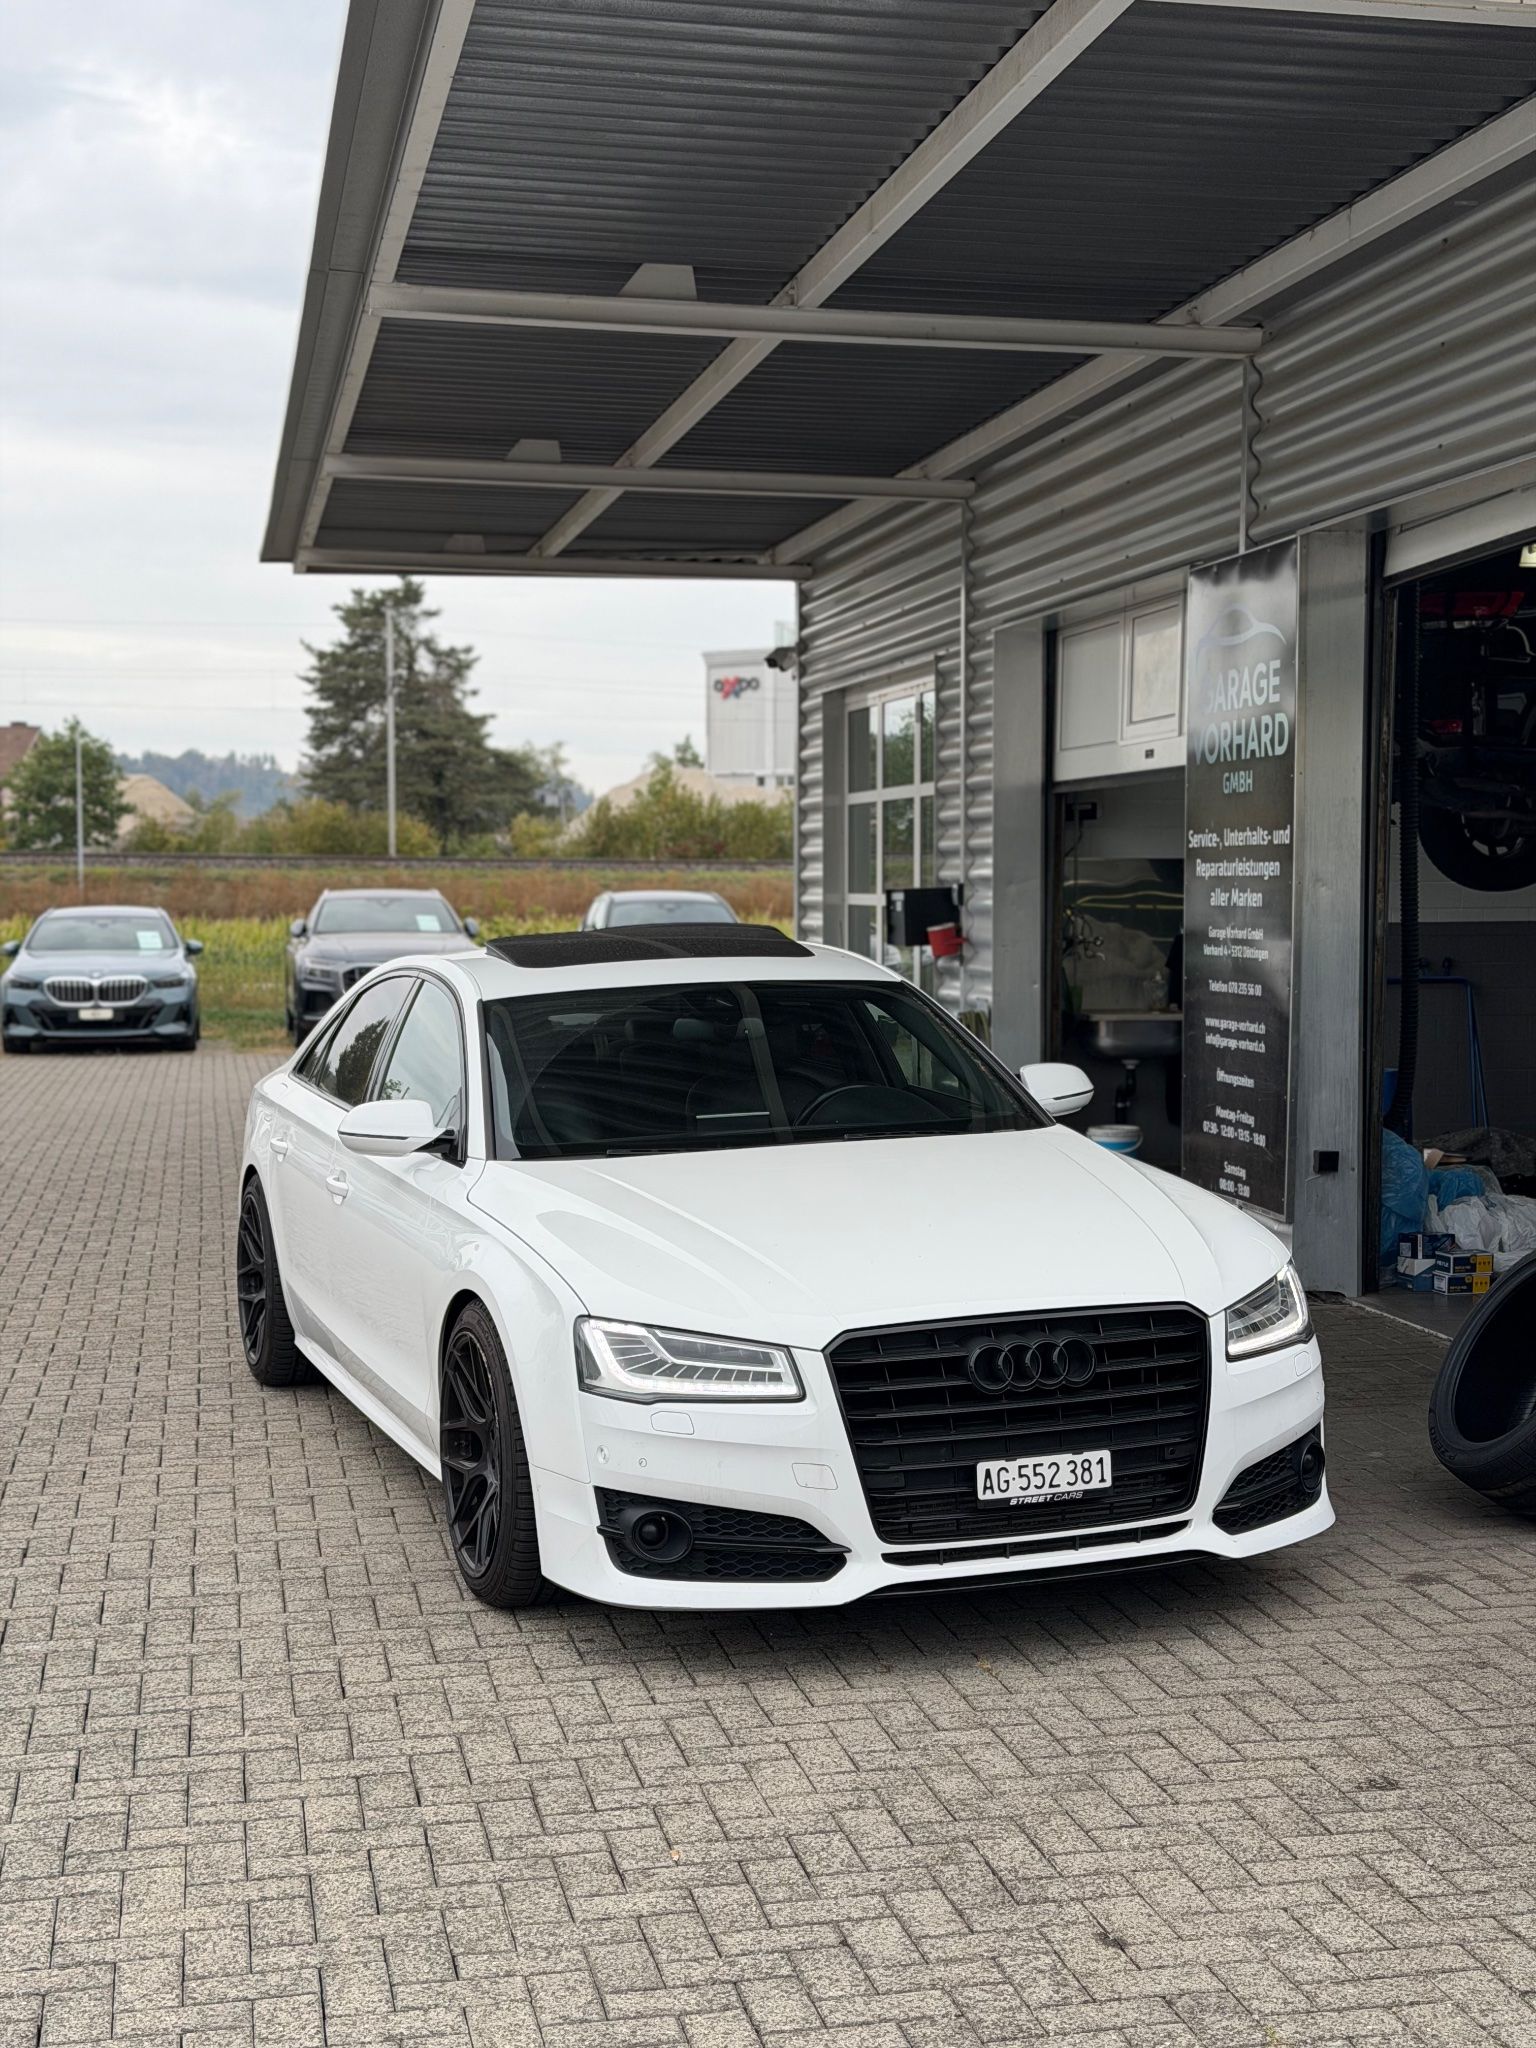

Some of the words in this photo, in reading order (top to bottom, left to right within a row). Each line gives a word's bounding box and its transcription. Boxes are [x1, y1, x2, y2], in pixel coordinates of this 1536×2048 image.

[1194, 713, 1289, 765] VORHARD
[1222, 770, 1253, 794] GMBH
[1224, 826, 1271, 846] Unterhalts-
[1273, 824, 1290, 845] und
[1196, 857, 1280, 880] Reparaturleistungen
[1210, 888, 1229, 907] aller
[1231, 888, 1263, 907] Marken
[1208, 925, 1226, 941] Garage
[1226, 925, 1247, 939] Vorhard
[1247, 927, 1264, 940] GmbH
[1203, 944, 1223, 956] Vorhard
[1224, 945, 1228, 957] 4
[1231, 945, 1242, 958] 5312
[1243, 946, 1269, 961] Döttingen
[1208, 979, 1228, 993] Telefon
[1204, 1017, 1266, 1034] www.garage-vorhard.ch
[1205, 1032, 1266, 1053] info@garage-vorhard.ch
[1216, 1067, 1255, 1088] Öffnungszeiten
[1215, 1105, 1255, 1128] Montag-Freitag
[1224, 1161, 1247, 1181] Samstag
[1009, 1494, 1053, 1506] STREET
[1053, 1491, 1083, 1501] CARS
